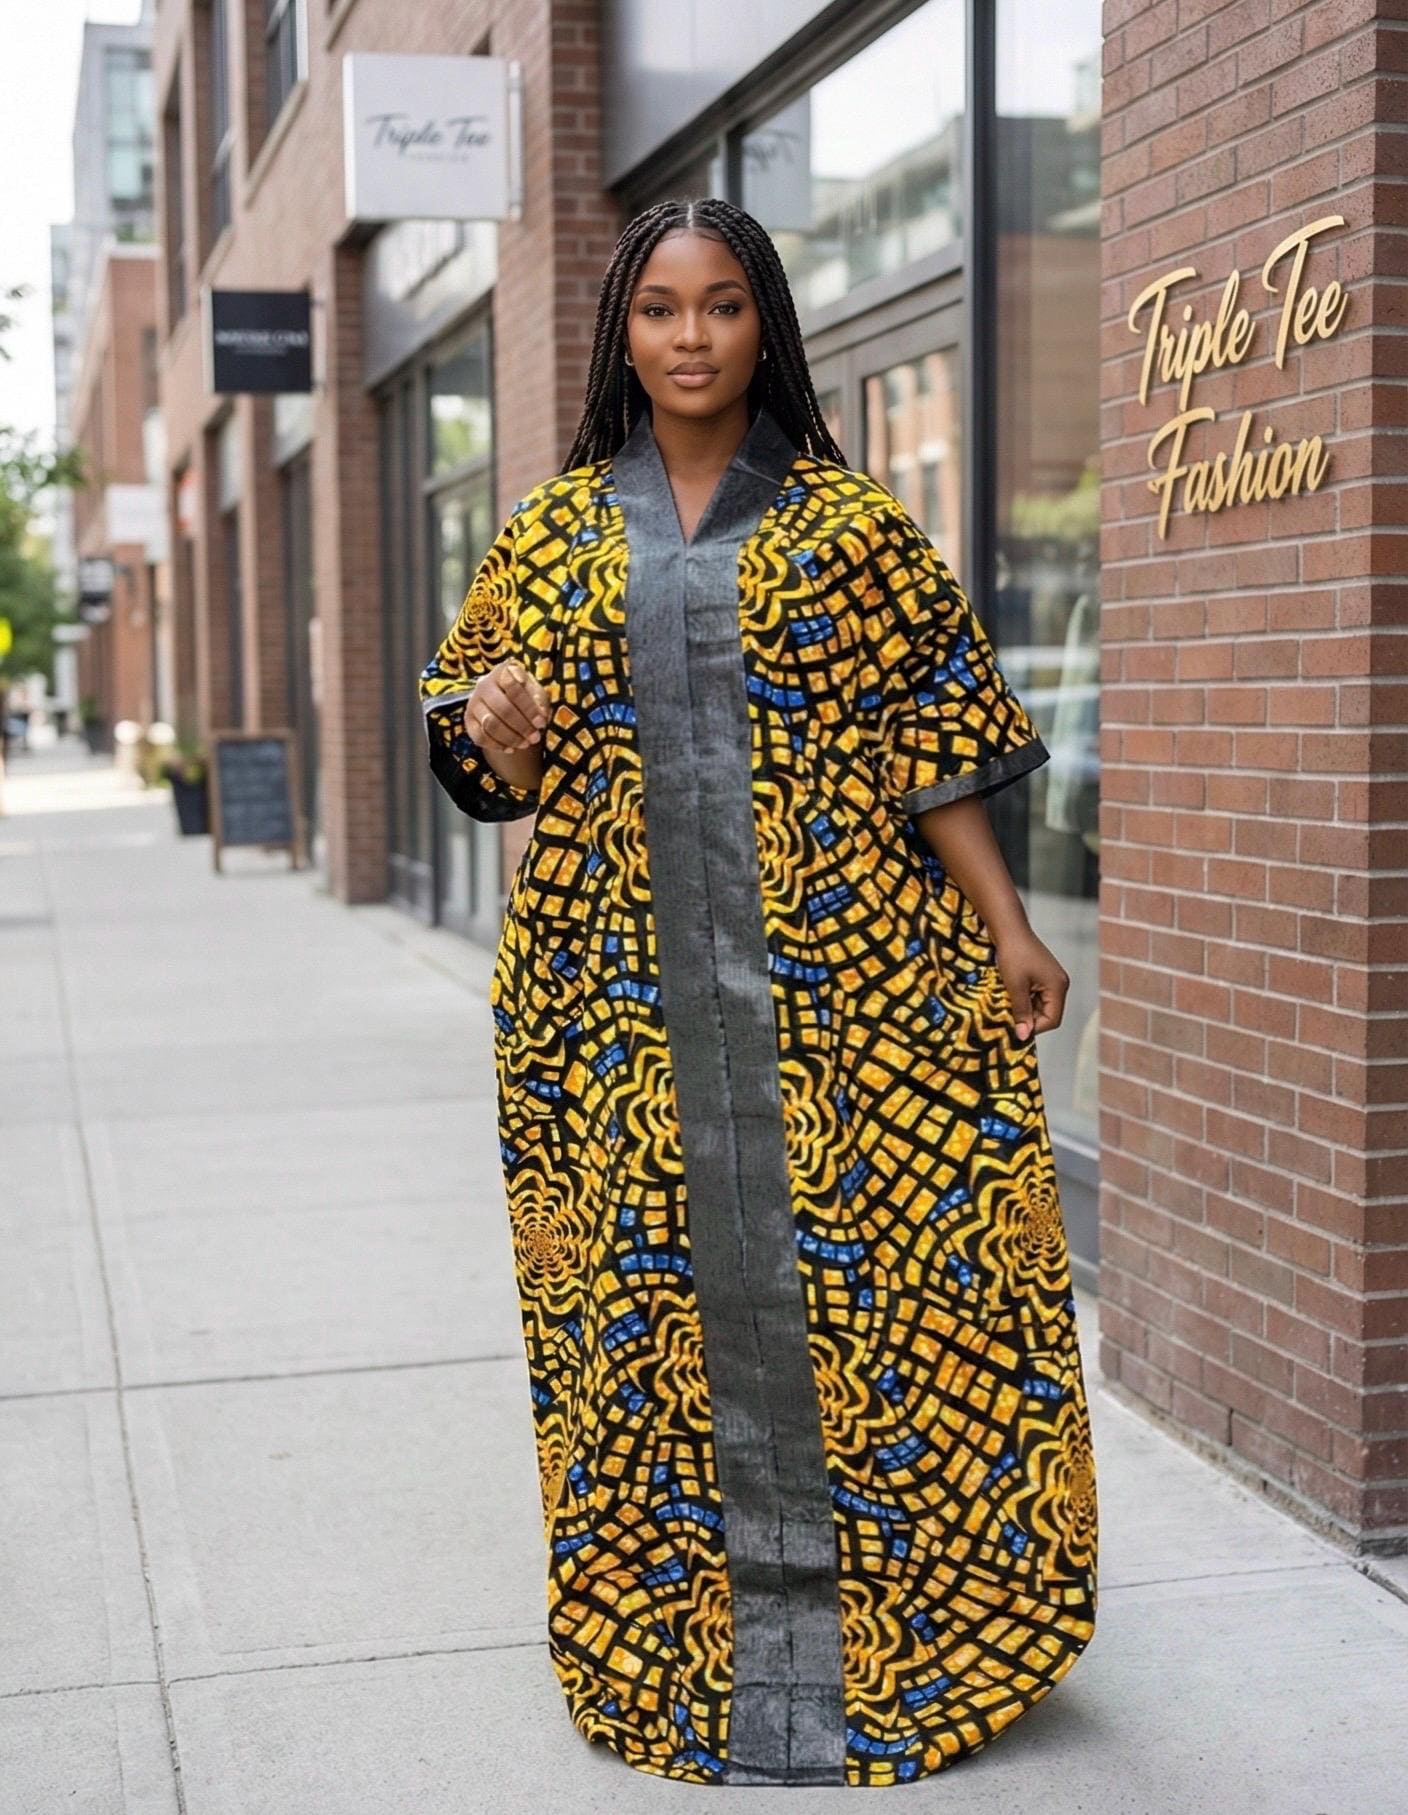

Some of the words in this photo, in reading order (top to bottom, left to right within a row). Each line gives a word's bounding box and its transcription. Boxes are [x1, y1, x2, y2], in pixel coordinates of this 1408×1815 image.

[366, 113, 443, 155] Triple
[447, 115, 492, 149] Tee
[1128, 266, 1256, 412] Triple
[1262, 215, 1348, 370] Tee
[1147, 406, 1330, 540] Fashion
